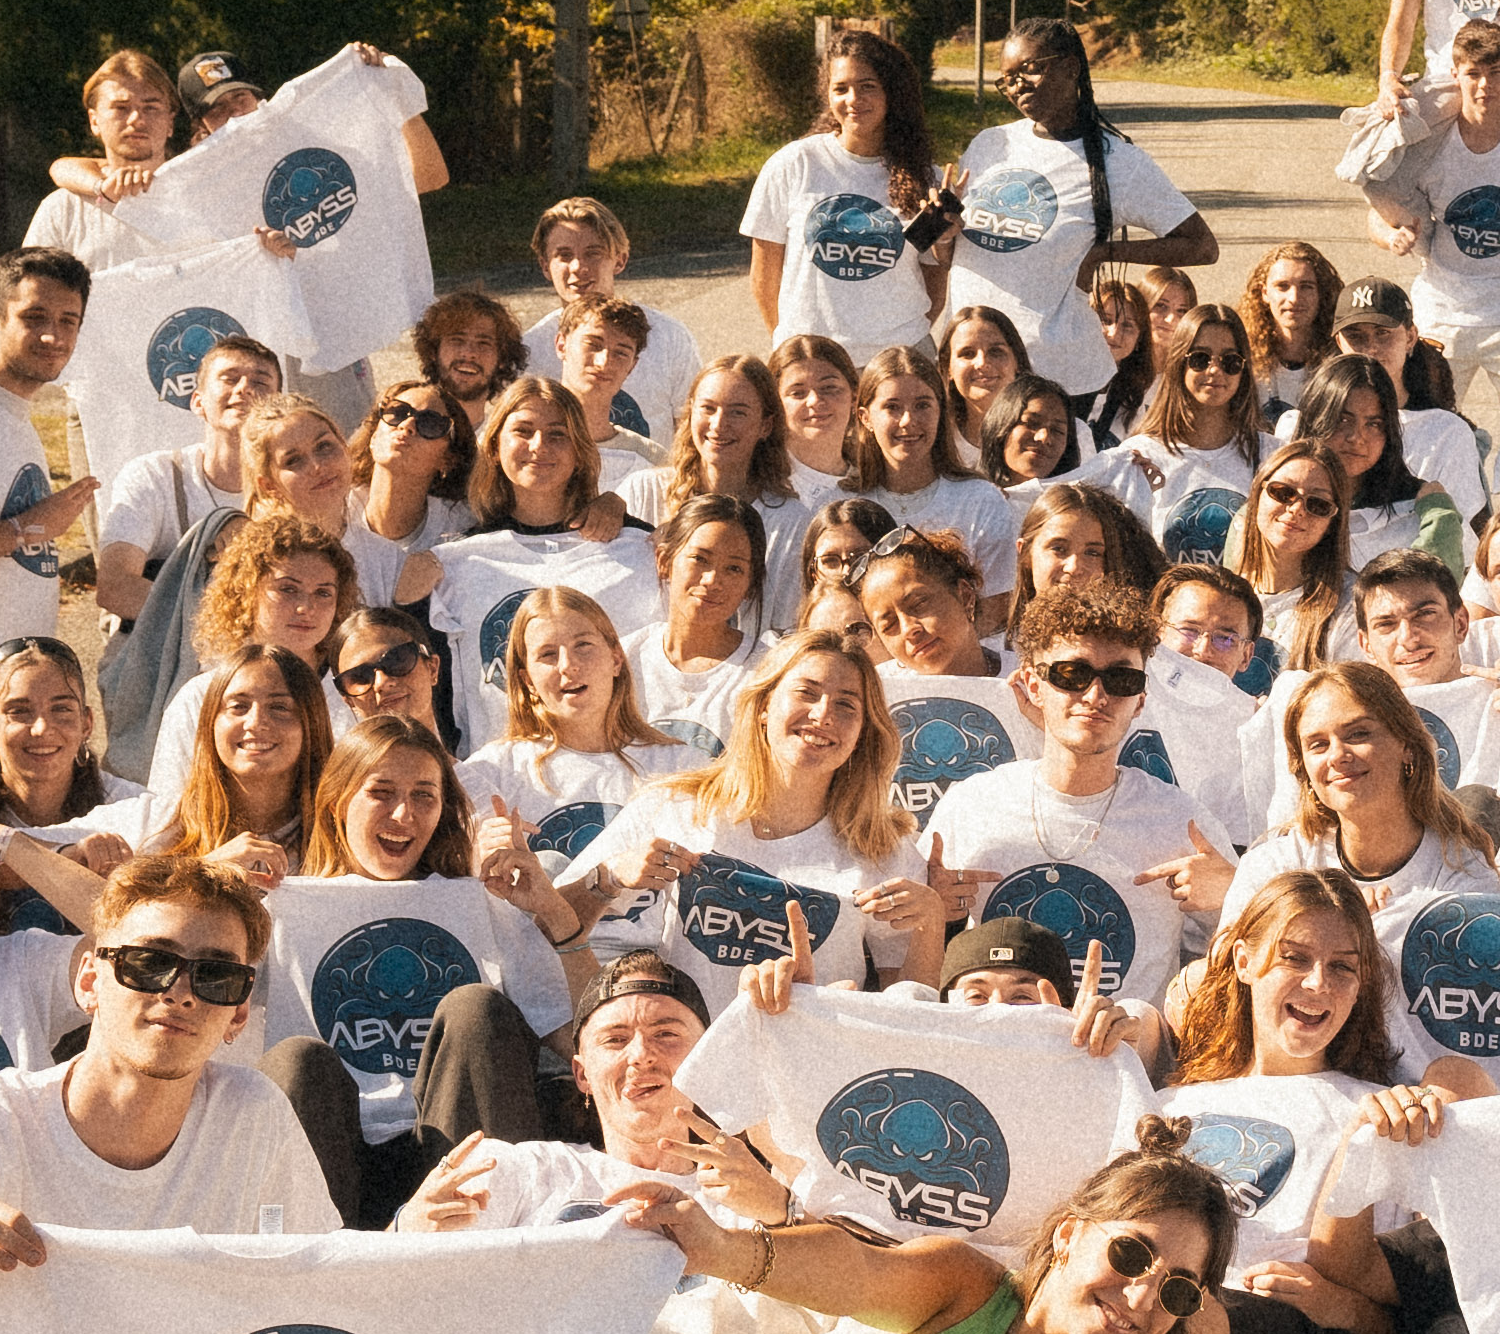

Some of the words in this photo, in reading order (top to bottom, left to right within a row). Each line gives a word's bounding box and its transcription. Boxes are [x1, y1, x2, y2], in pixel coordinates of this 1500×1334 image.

[284, 186, 357, 241] ABYSS
[961, 207, 1043, 242] ABYSS
[981, 236, 1005, 249] BDE
[809, 242, 897, 267] ABYSS
[839, 267, 863, 277] BDE
[717, 944, 755, 961] BDE
[1460, 1032, 1499, 1049] BDE
[382, 1053, 417, 1071] BDE
